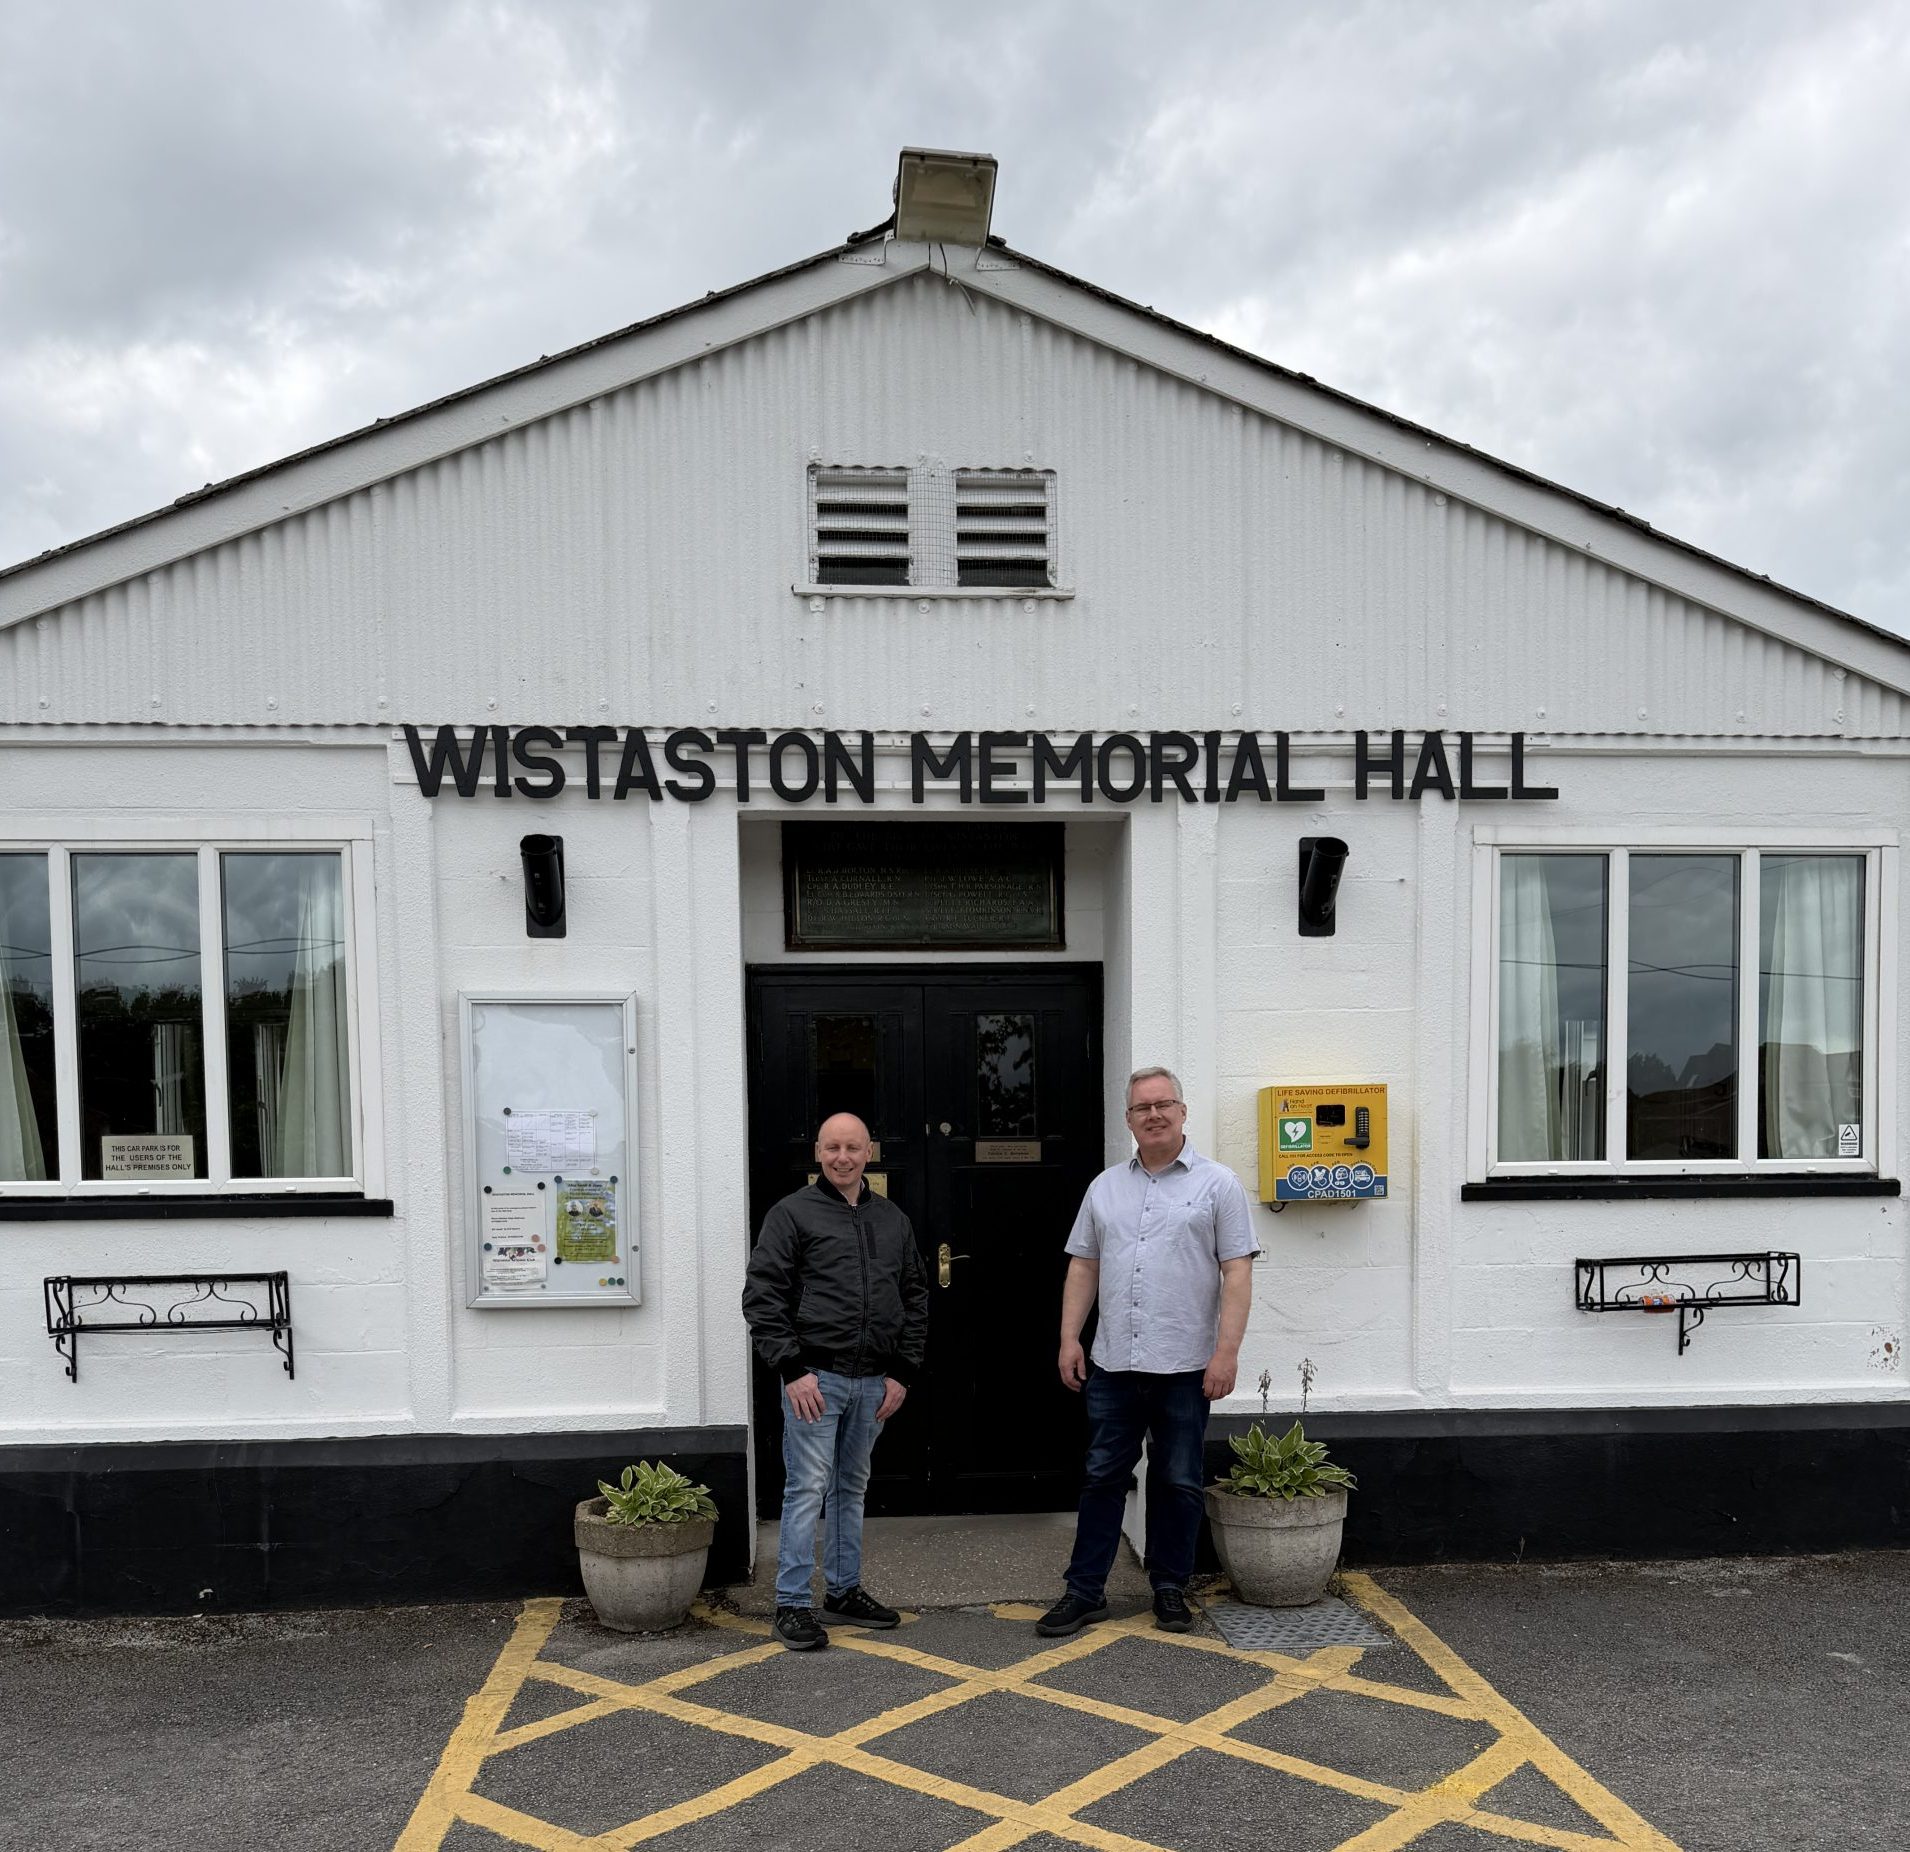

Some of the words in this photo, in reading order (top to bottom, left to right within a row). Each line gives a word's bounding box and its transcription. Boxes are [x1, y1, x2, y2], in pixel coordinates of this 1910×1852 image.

[403, 724, 874, 803] WISTASTON
[912, 731, 1325, 803] MEMORIAL
[1356, 730, 1559, 800] HALL
[1308, 1190, 1356, 1198] CPAD1501
